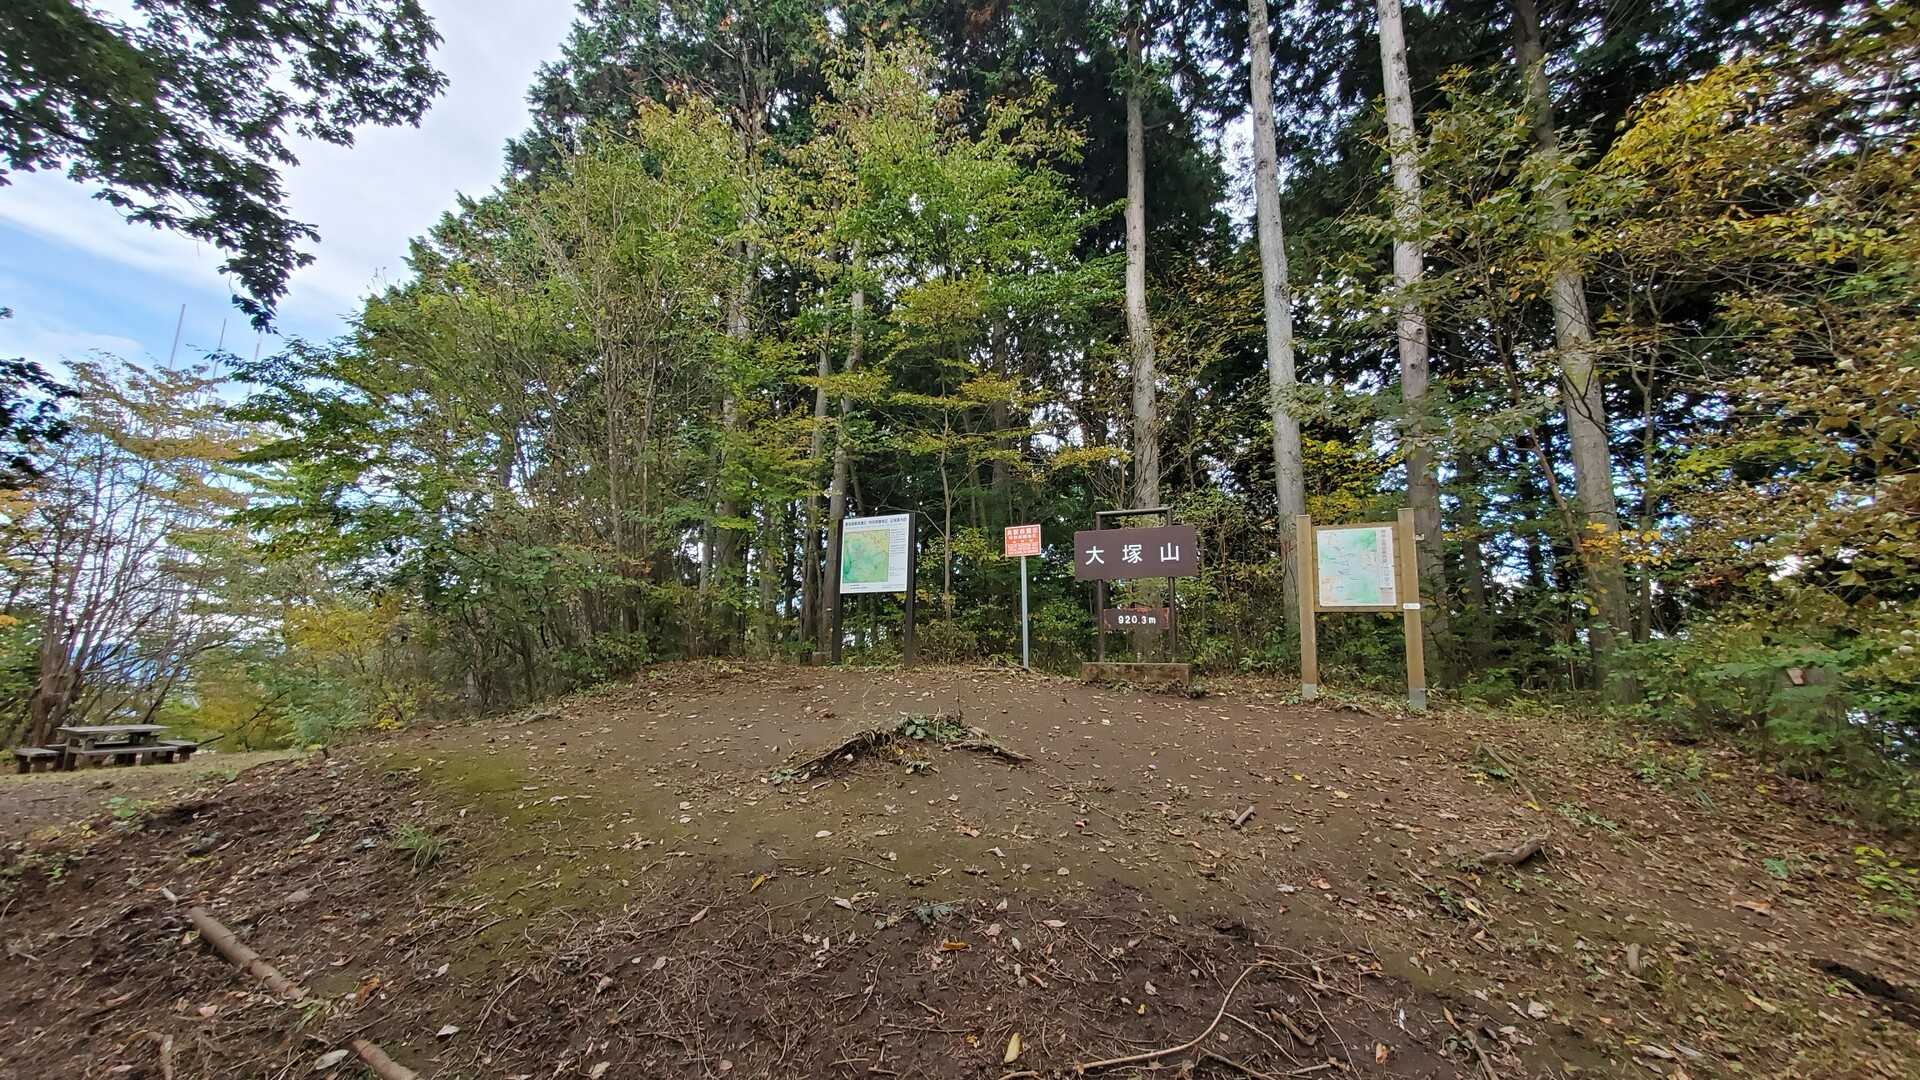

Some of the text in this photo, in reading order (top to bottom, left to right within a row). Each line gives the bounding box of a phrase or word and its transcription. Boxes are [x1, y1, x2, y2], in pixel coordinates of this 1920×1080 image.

[1085, 542, 1180, 566] 大塚山
[1118, 615, 1157, 625] 920.3m
